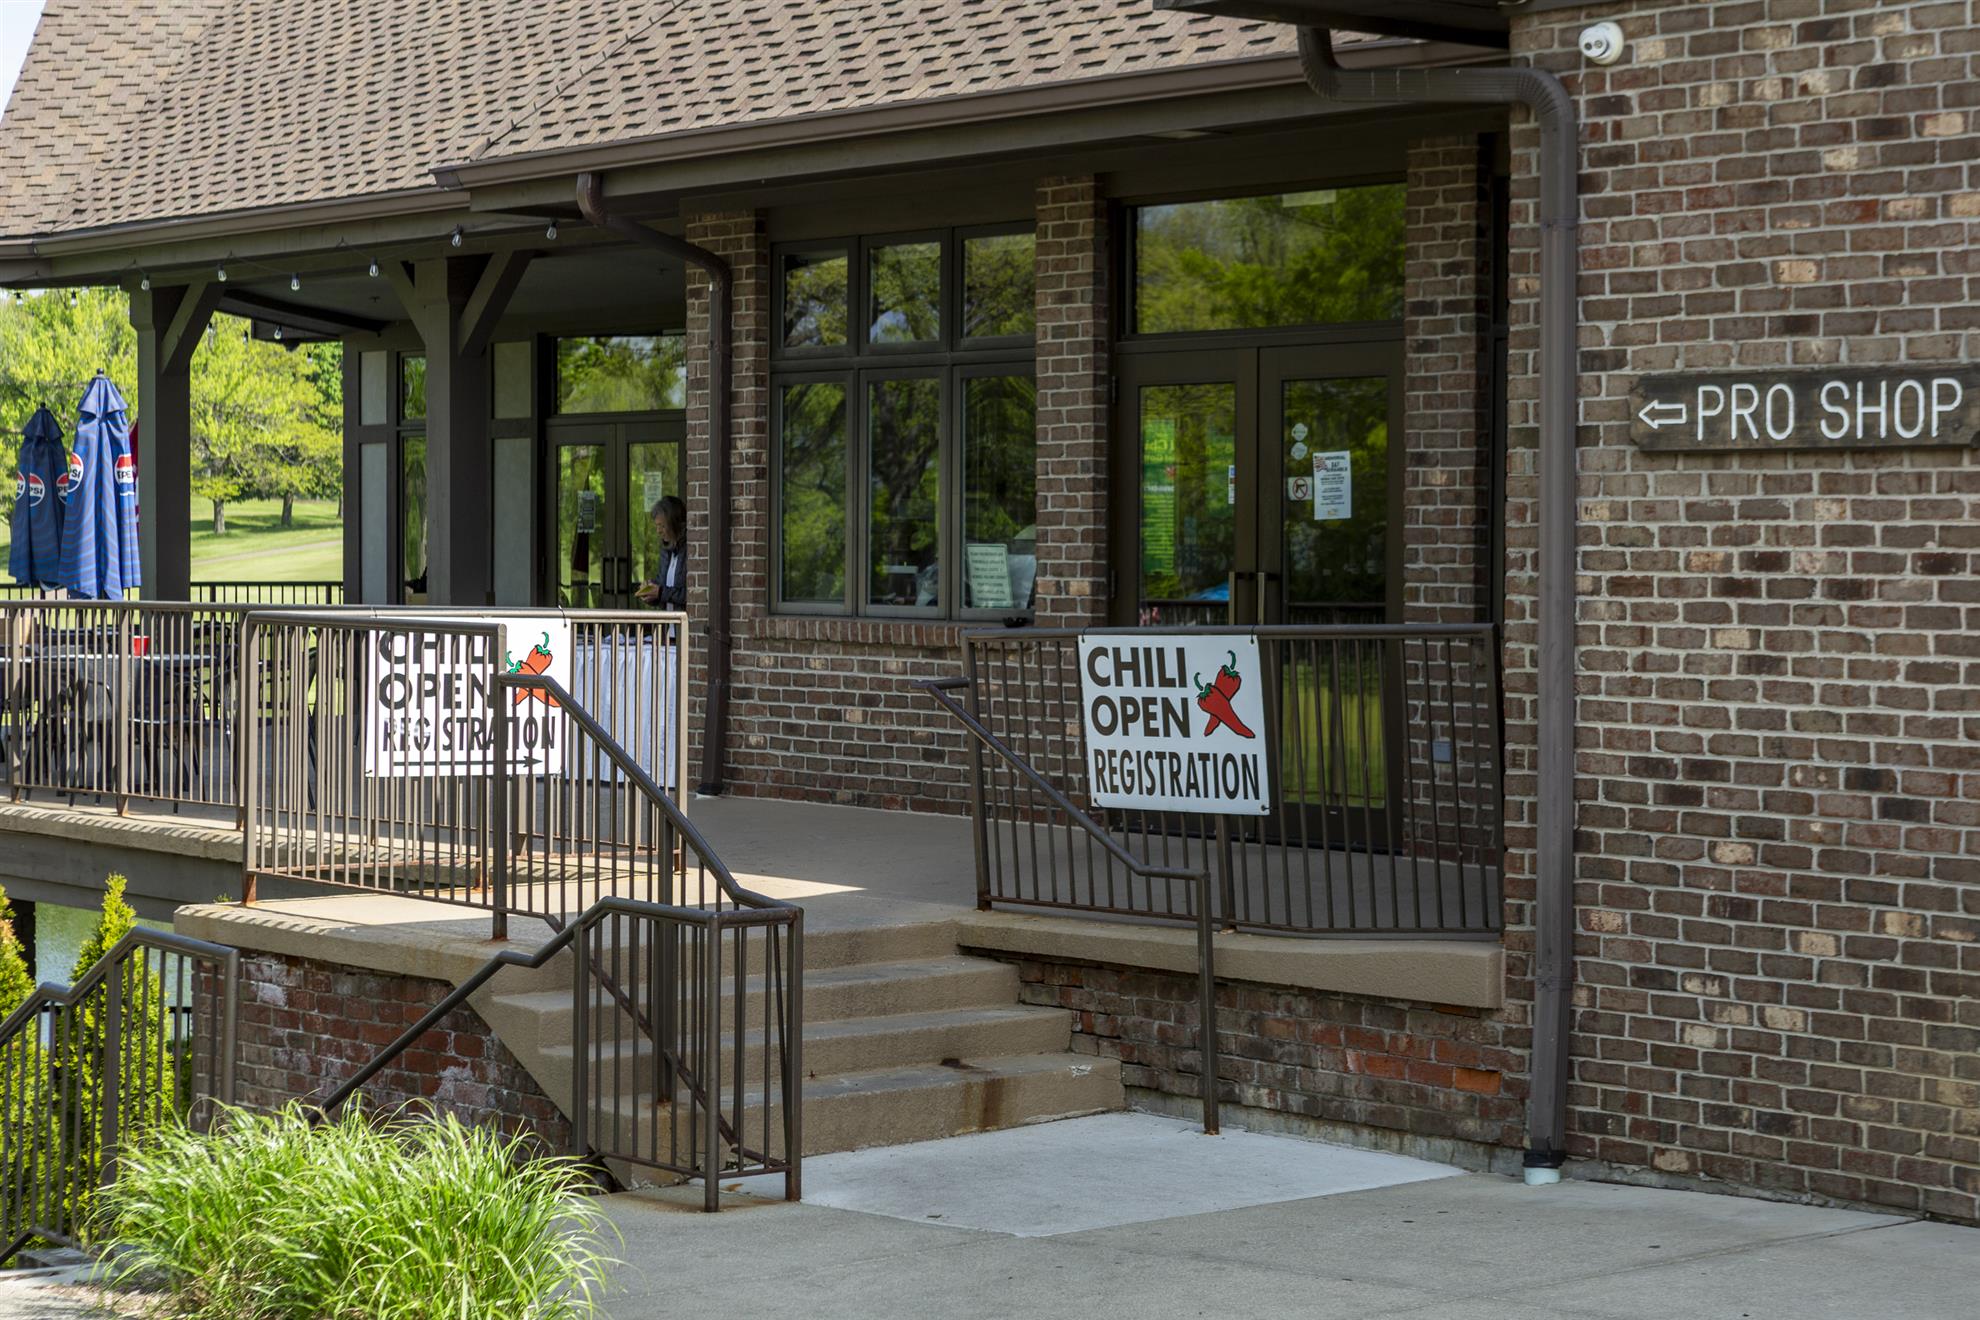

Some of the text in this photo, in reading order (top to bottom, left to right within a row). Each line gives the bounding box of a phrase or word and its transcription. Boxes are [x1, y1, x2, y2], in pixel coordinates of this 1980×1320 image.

[1697, 378, 1963, 441] PRO SHOP
[1087, 647, 1188, 688] CHILI
[379, 673, 495, 710] OPEN
[383, 716, 556, 752] REGSTRAION
[1091, 695, 1191, 738] OPEN
[1093, 749, 1260, 800] REGISTRATION
